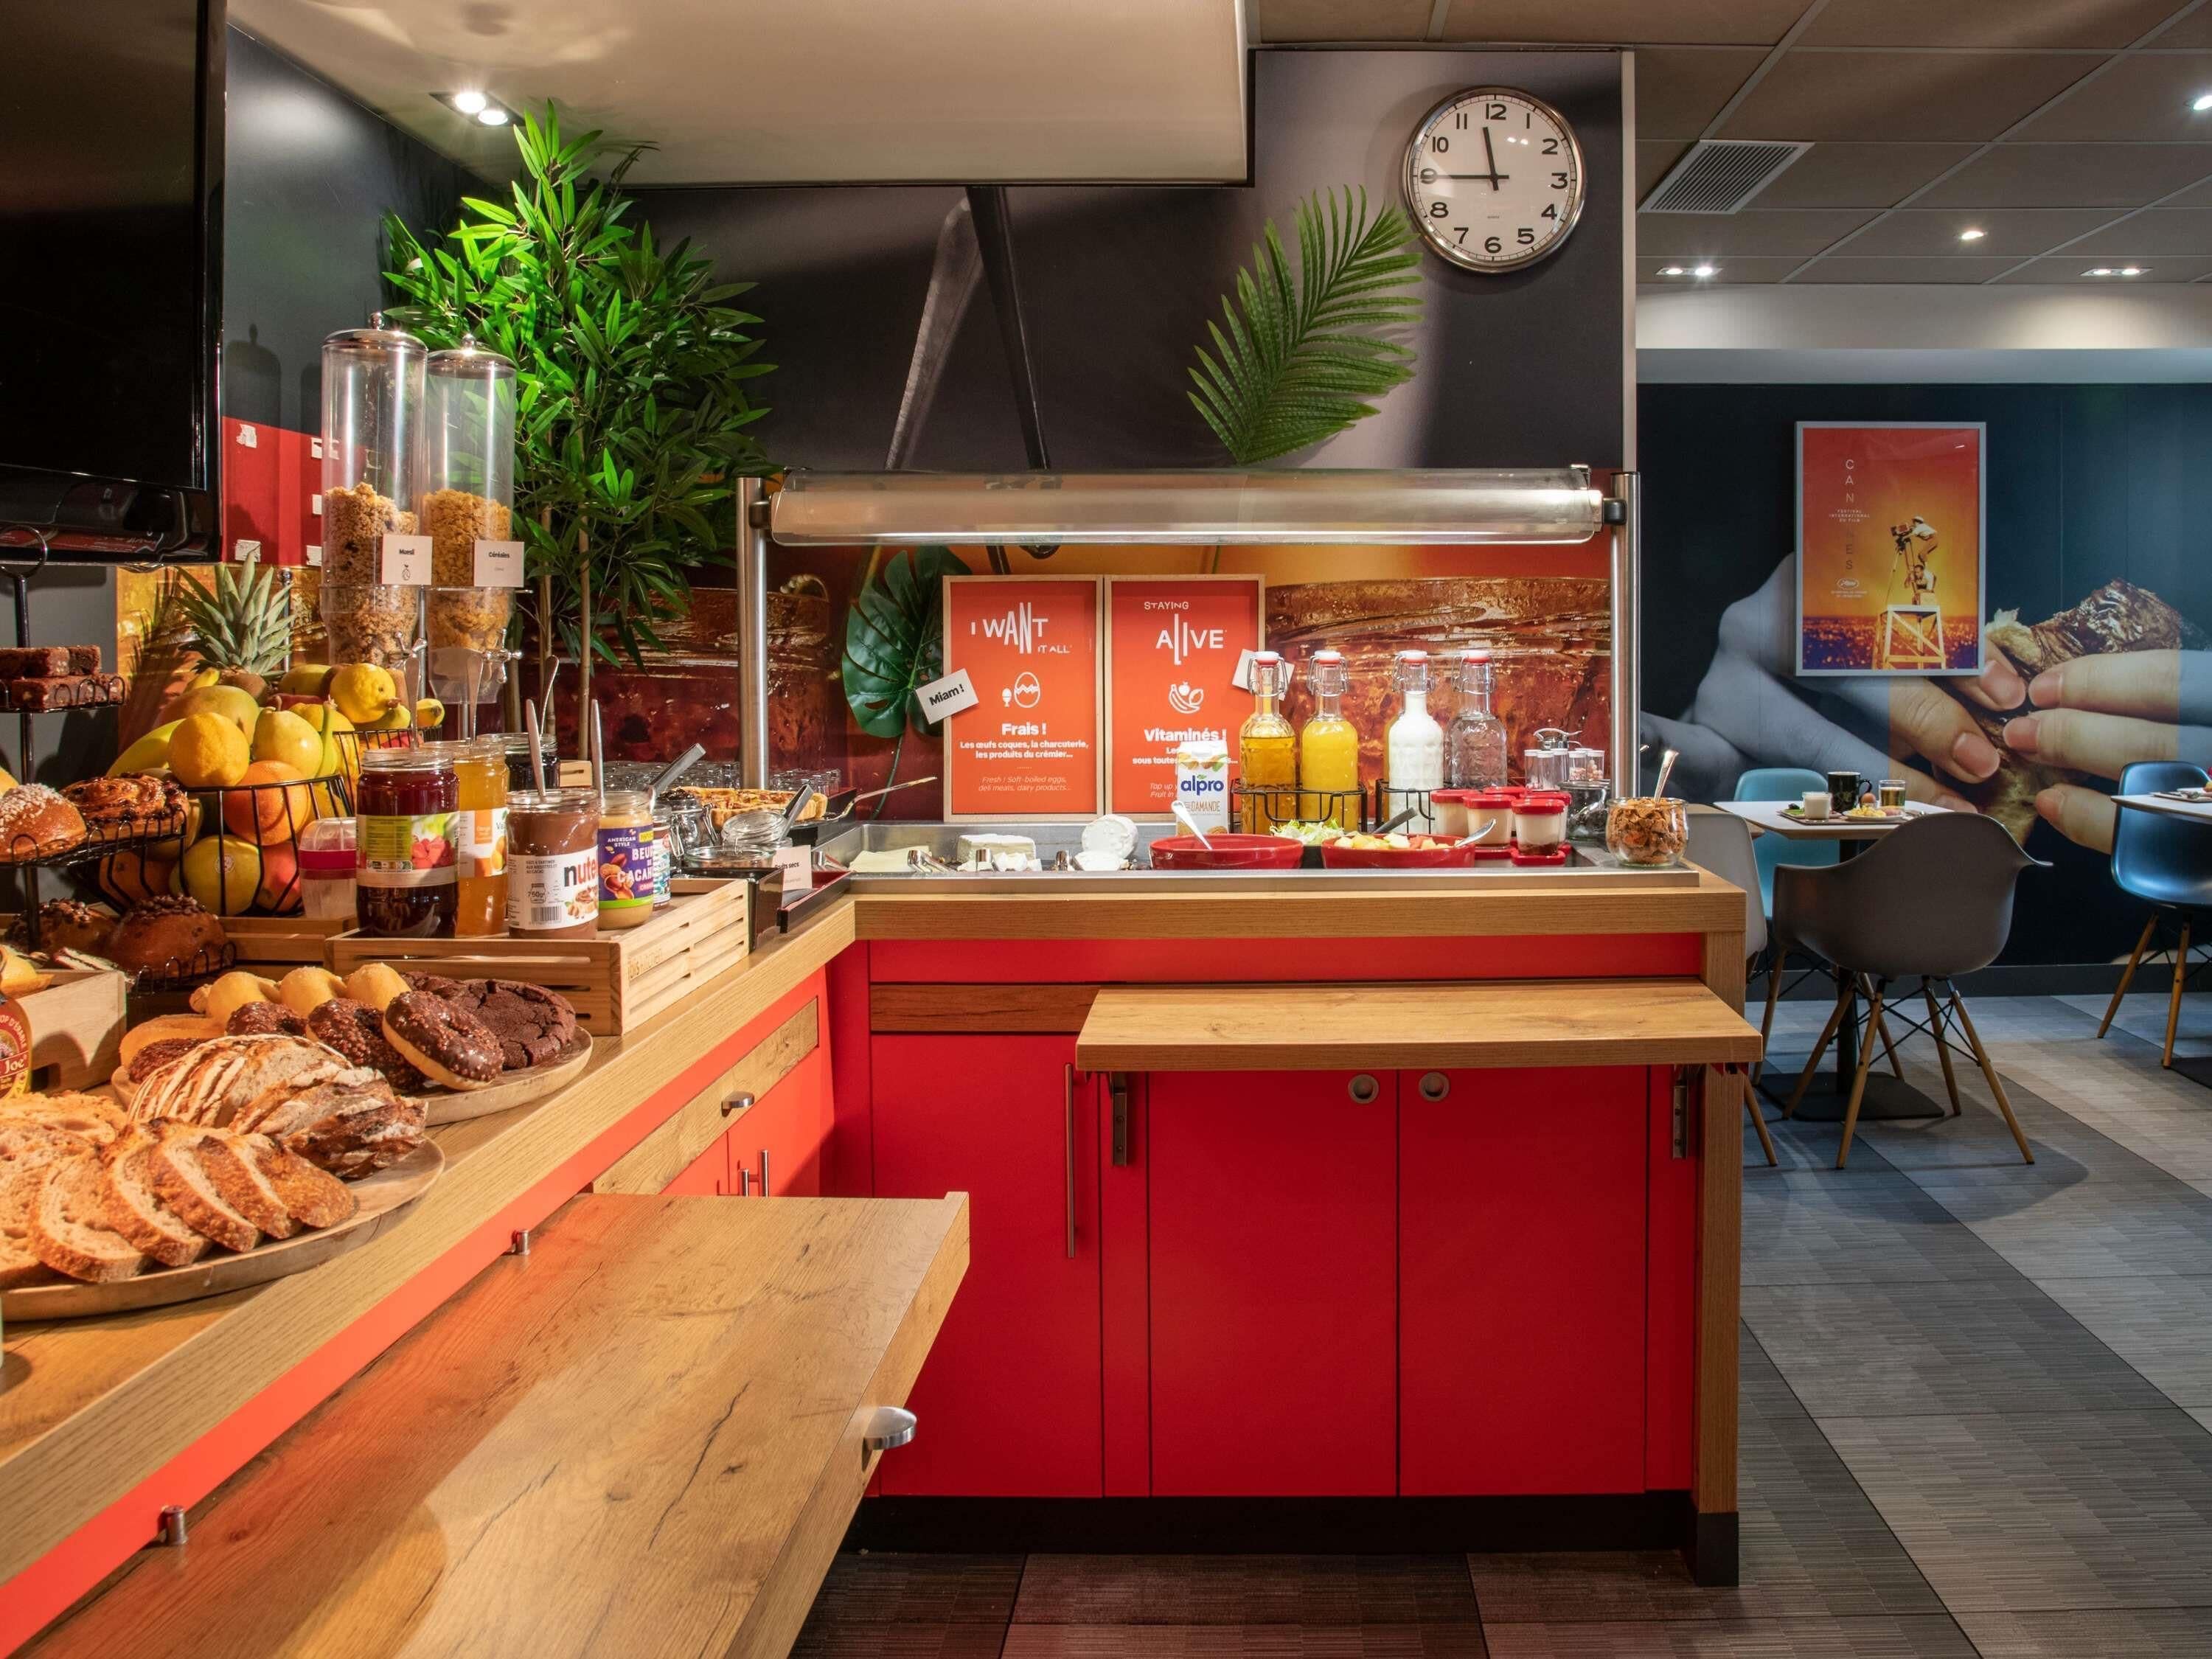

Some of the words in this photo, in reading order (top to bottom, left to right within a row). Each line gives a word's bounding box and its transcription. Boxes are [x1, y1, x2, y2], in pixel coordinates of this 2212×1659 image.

[1485, 103, 1507, 120] 12
[1455, 113, 1468, 130] 11
[1526, 113, 1531, 129] 1
[1432, 136, 1449, 153] 10
[1541, 138, 1559, 155] 2
[1420, 167, 1438, 184] 9
[1551, 173, 1568, 189] 3
[1430, 201, 1449, 218] 8
[1541, 204, 1558, 220] 4
[1453, 227, 1469, 244] 7
[1517, 228, 1535, 245] 5
[1484, 236, 1502, 254] 6
[1845, 459, 1855, 571] CANES
[1144, 601, 1190, 611] STAYING
[971, 622, 976, 636] I
[982, 602, 1049, 655] WANT
[1155, 613, 1225, 666] ALIVE
[1037, 644, 1048, 654] IT
[1049, 644, 1071, 654] ALL
[929, 686, 960, 706] Miam
[1001, 722, 1039, 736] Frais
[1042, 723, 1047, 735] !
[1144, 727, 1219, 742] Vitaminés
[960, 741, 975, 749] Les
[975, 740, 997, 749] œufs
[998, 741, 1030, 751] coques,
[1031, 740, 1038, 748] la
[1040, 740, 1089, 749] charcuterie,
[975, 750, 988, 759] les
[989, 750, 1023, 761] produits
[1023, 750, 1034, 759] du
[1180, 775, 1225, 796] alpro
[563, 857, 597, 888] nute
